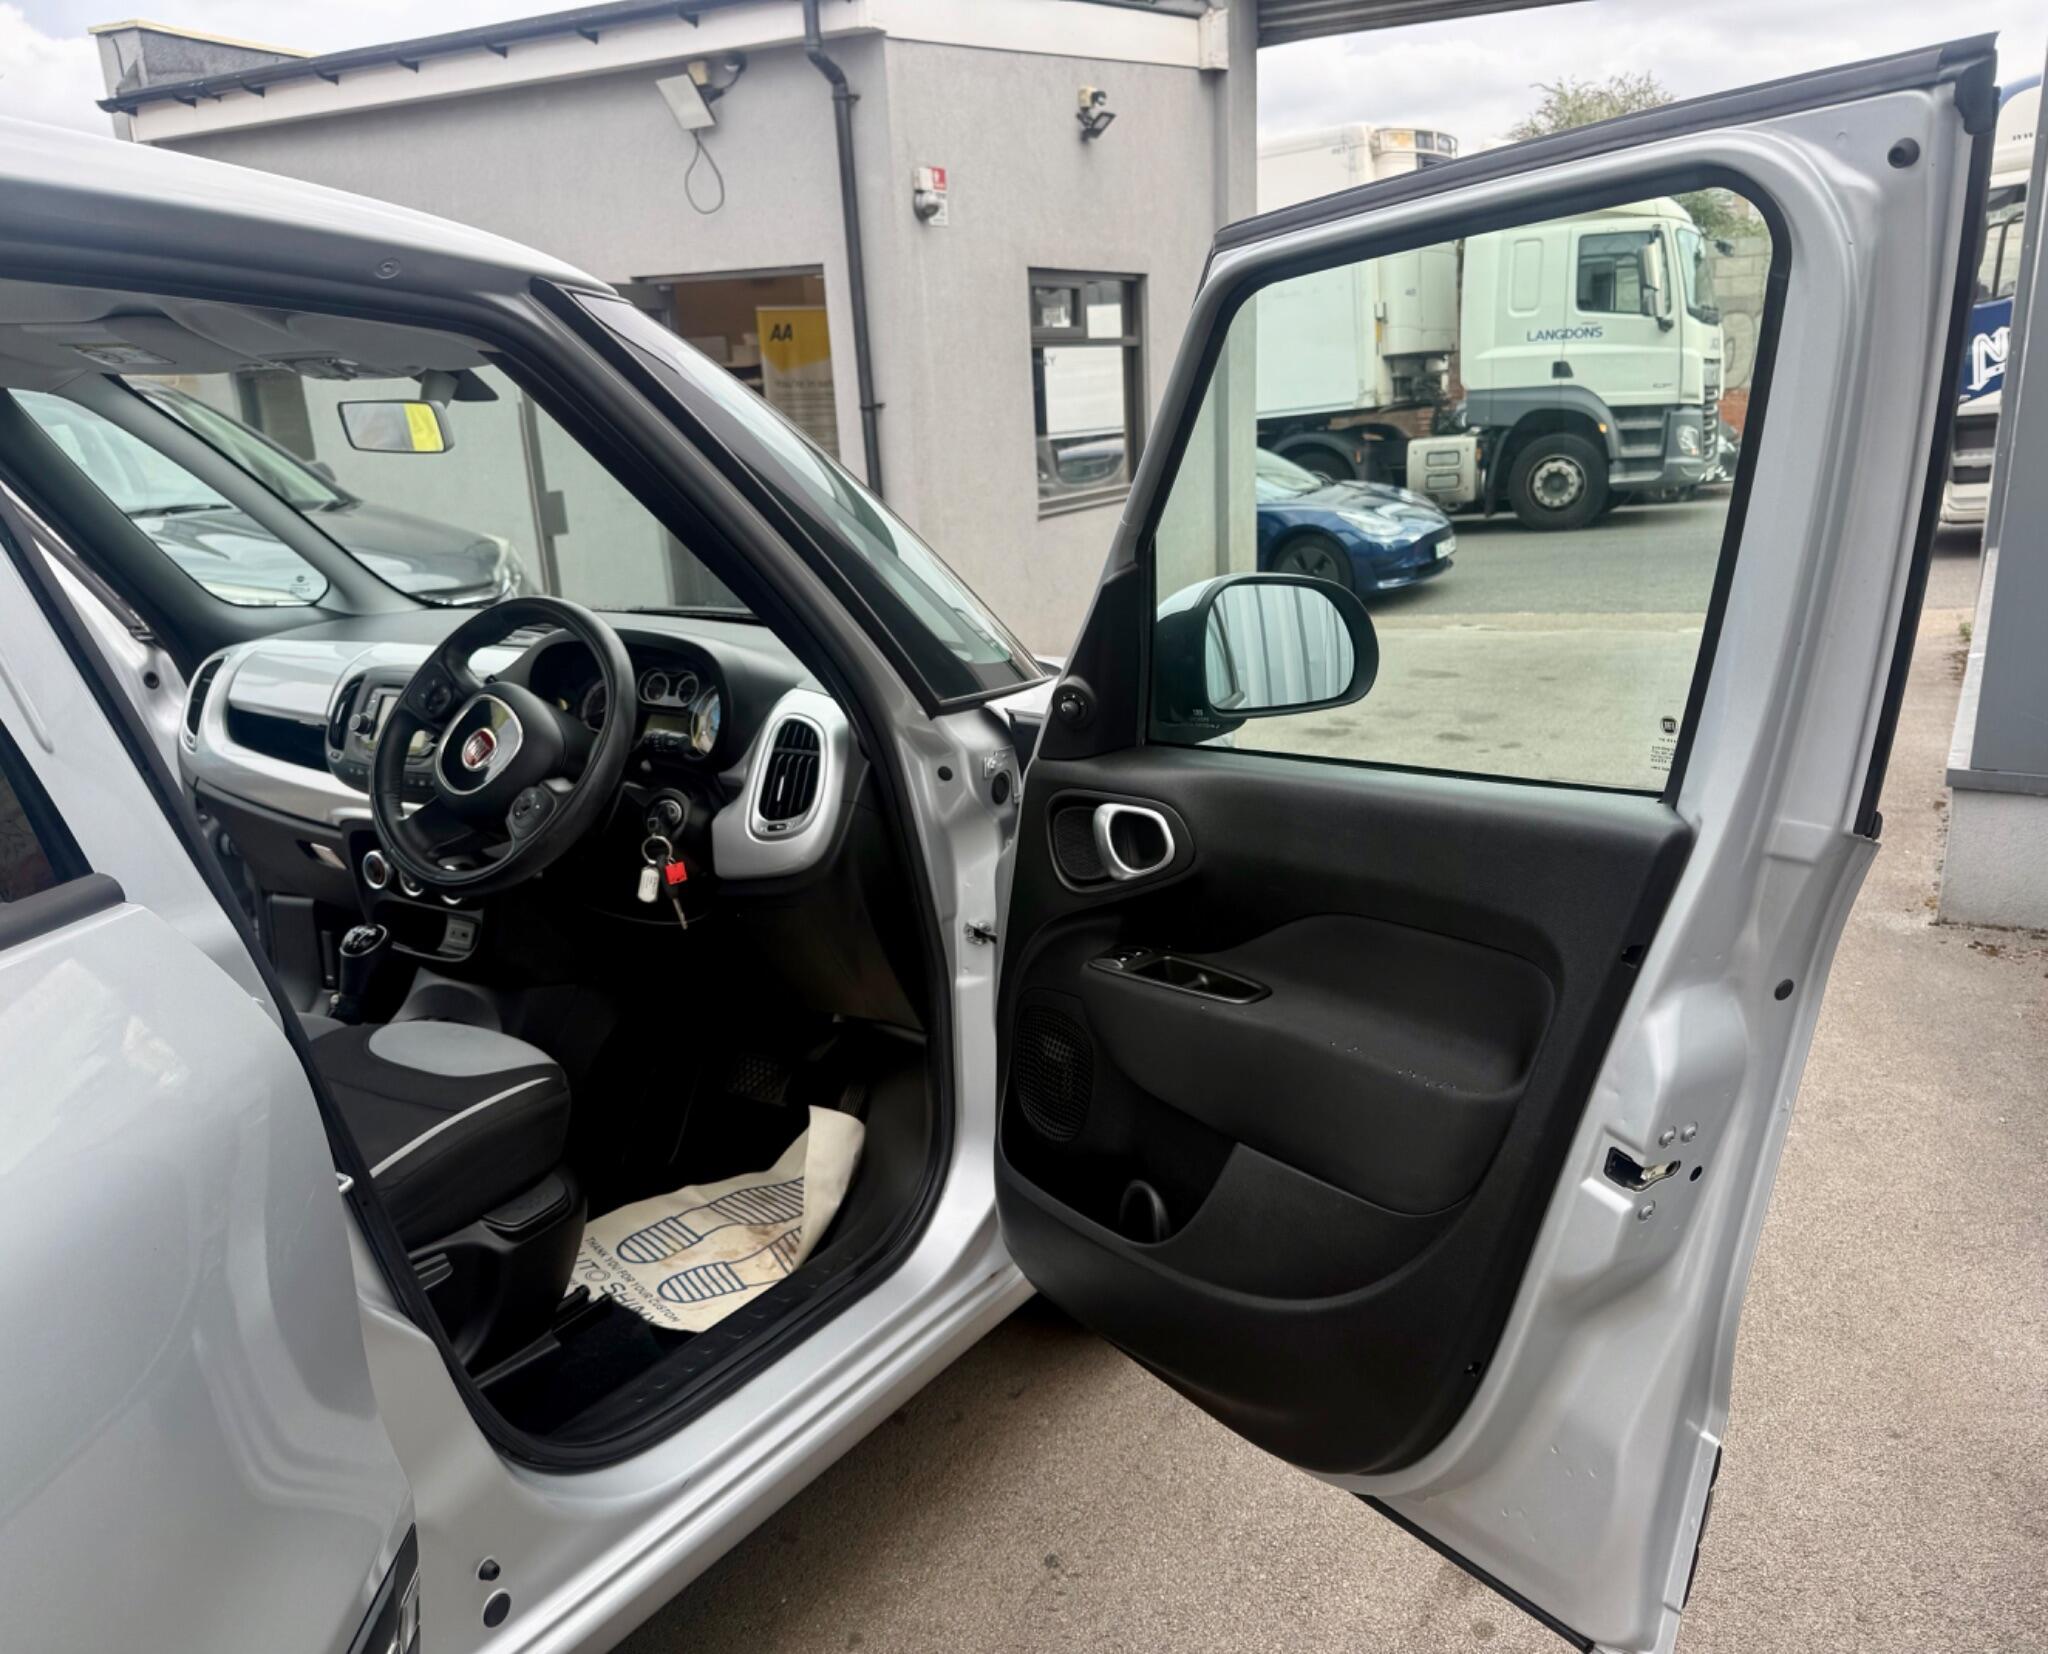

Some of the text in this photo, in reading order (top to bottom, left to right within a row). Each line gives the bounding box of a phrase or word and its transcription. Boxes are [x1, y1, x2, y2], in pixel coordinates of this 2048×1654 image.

[769, 323, 793, 342] AA
[1526, 326, 1603, 342] LANGDONS
[586, 1236, 609, 1258] THANK
[631, 1281, 654, 1299] YOUR
[648, 1296, 680, 1323] CUSTOM
